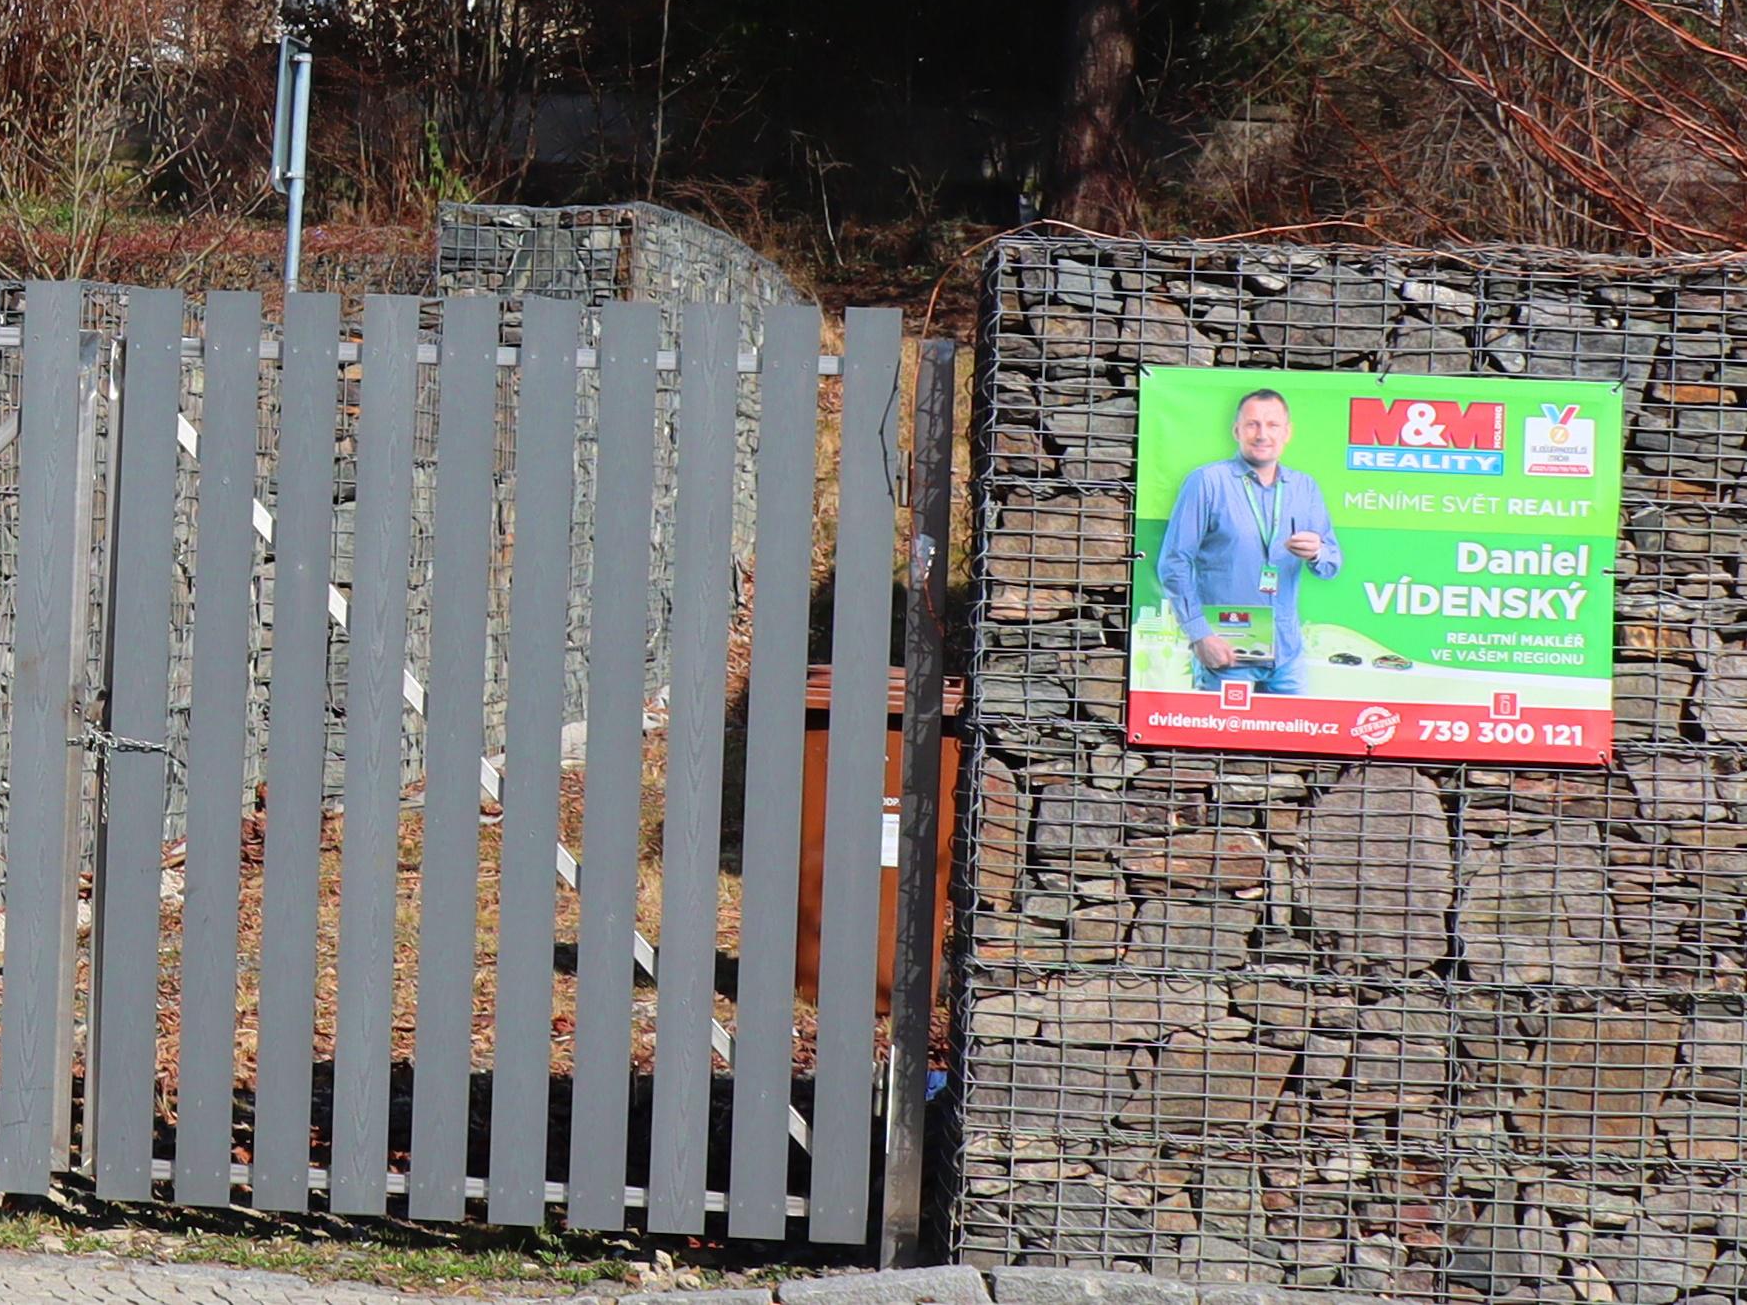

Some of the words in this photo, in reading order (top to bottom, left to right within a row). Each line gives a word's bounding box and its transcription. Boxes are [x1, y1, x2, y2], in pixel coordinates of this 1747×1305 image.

[1349, 397, 1494, 449] M&M
[1493, 405, 1503, 449] HOLDING
[1353, 451, 1498, 472] REALITY
[1344, 489, 1435, 513] MĚNÍME
[1442, 493, 1500, 515] SVĚT
[1507, 498, 1592, 517] REALIT
[1457, 542, 1589, 577] Daniel
[1363, 576, 1588, 620] VÍDENSKÝ
[1446, 632, 1517, 646] REALITNÍ
[1520, 632, 1585, 649] MAKLÉŘ
[1431, 648, 1452, 660] VE
[1456, 647, 1508, 663] VAŠEM
[1513, 651, 1584, 665] REGIONU
[1148, 712, 1339, 736] dvidensky@mmreality.cz
[1418, 720, 1470, 743] 739
[1477, 722, 1534, 744] 300
[1543, 724, 1583, 746] 121
